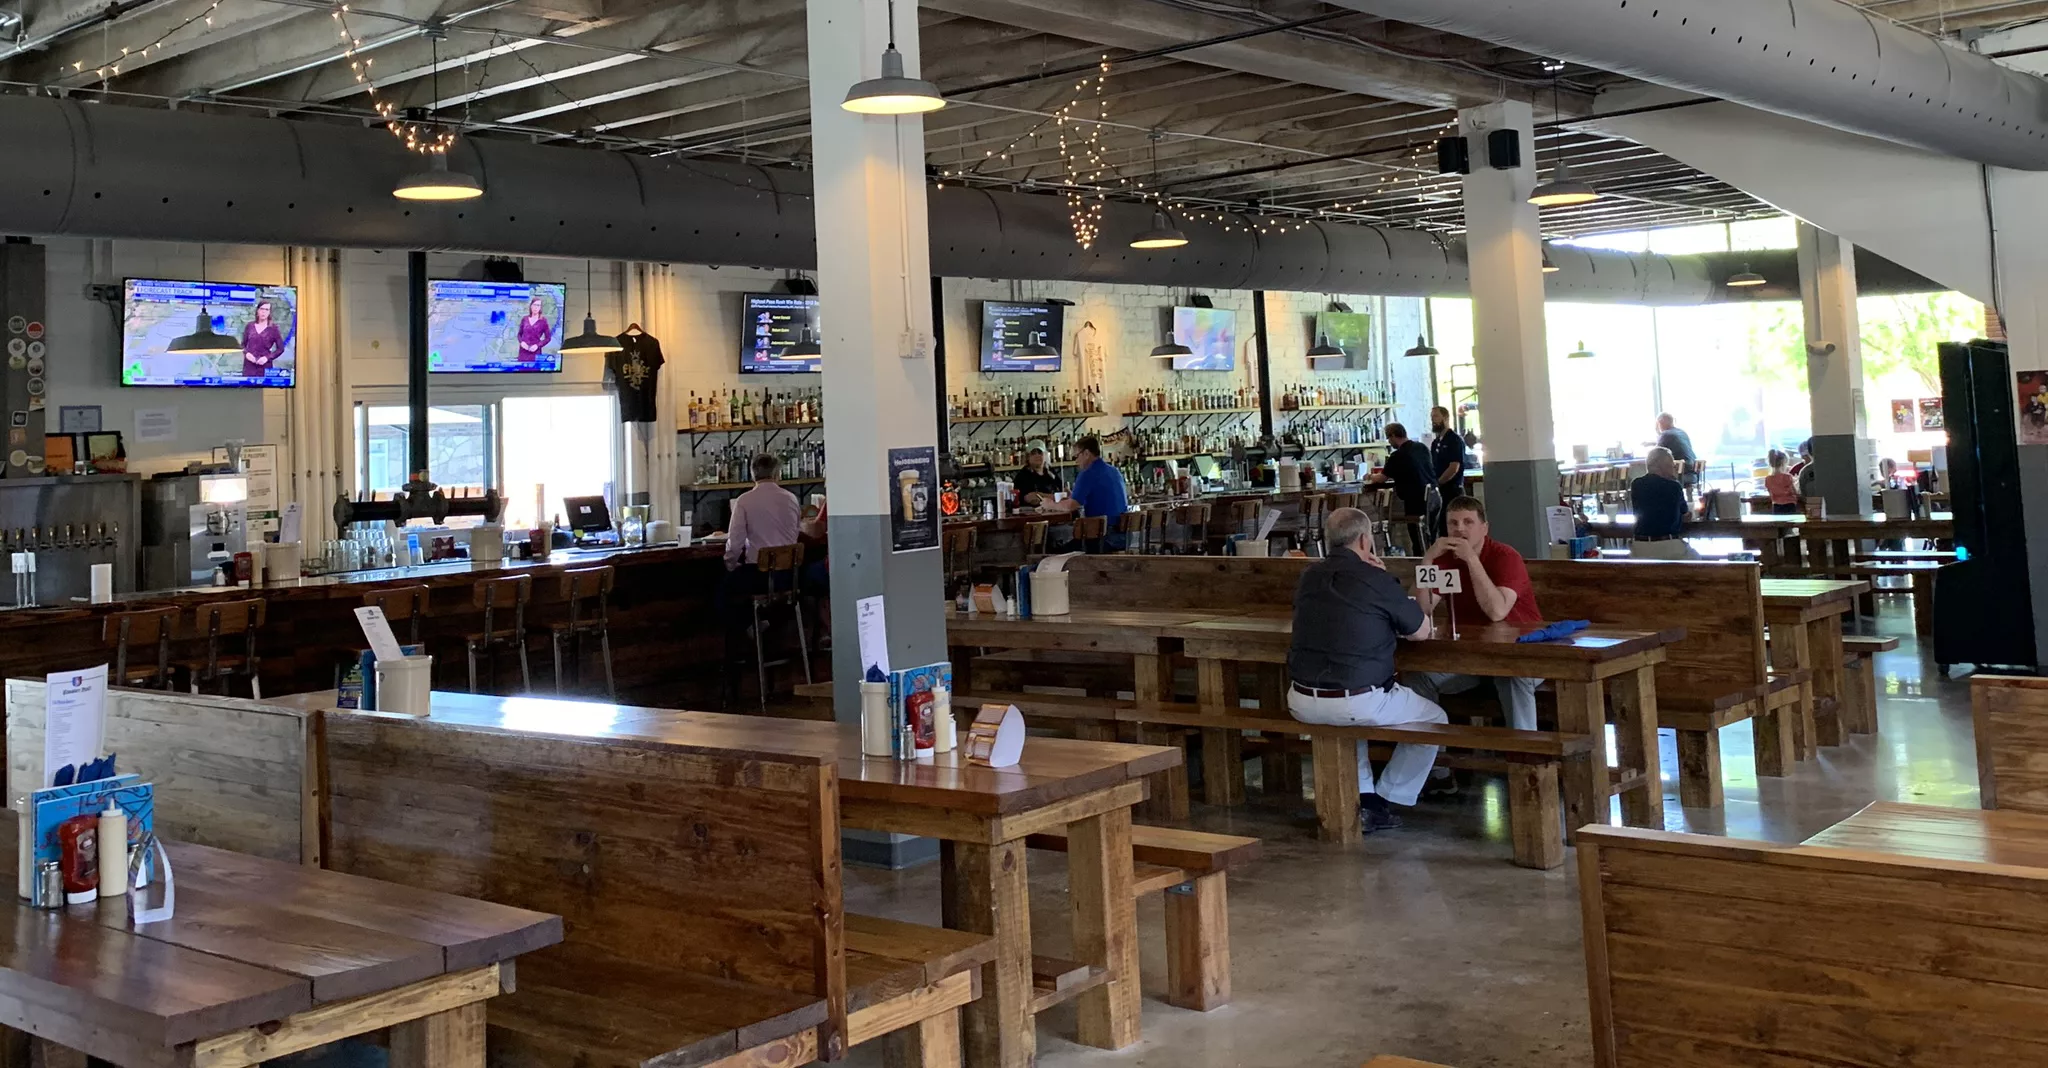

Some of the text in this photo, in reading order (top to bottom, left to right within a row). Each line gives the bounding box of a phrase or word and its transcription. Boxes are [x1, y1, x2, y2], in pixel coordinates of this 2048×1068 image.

[141, 287, 172, 295] FORECAST
[1419, 568, 1437, 583] 26
[1444, 572, 1454, 587] 2
